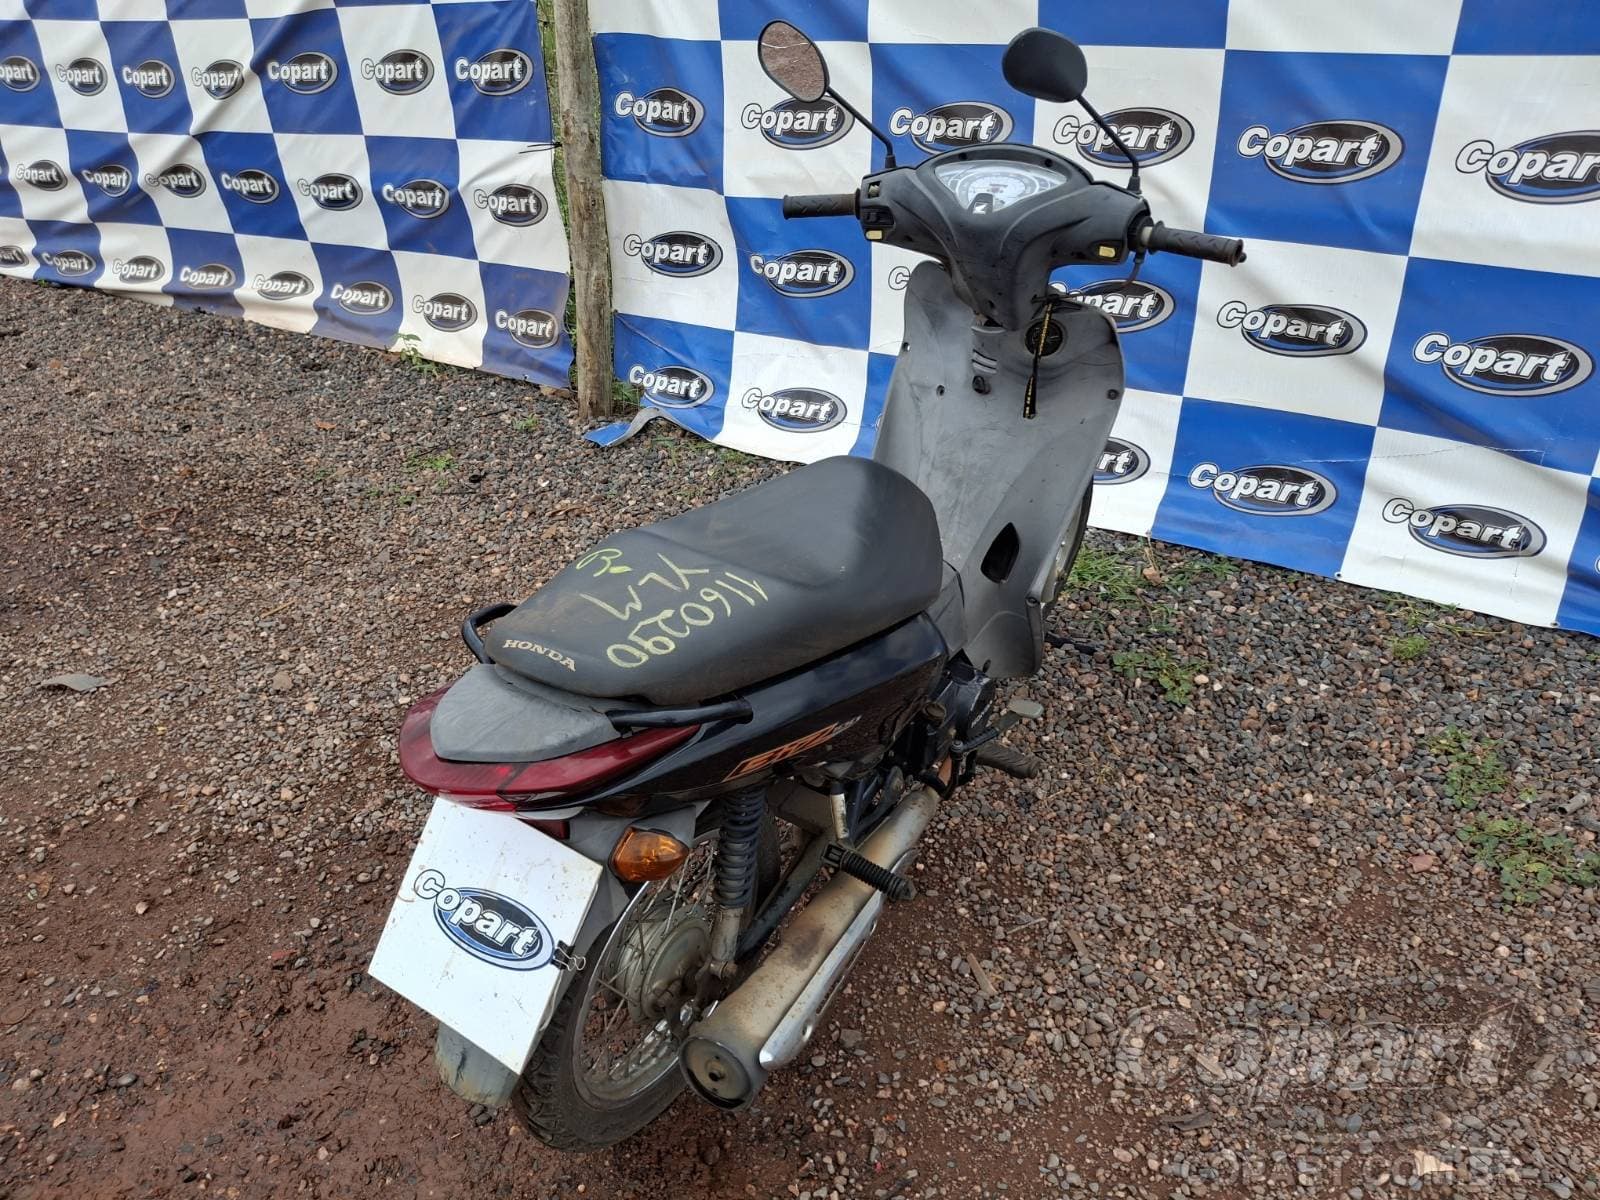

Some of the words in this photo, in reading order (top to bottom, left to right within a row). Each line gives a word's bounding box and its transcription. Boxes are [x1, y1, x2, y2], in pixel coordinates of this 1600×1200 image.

[55, 64, 101, 86] Copart
[122, 65, 168, 88] Copart
[191, 66, 240, 90] Copart
[267, 57, 329, 85] Copart
[361, 56, 424, 84] Copart
[455, 55, 523, 86] Copart
[615, 91, 691, 124] Copart
[741, 103, 840, 136] Copart
[889, 106, 997, 140] Copart
[1053, 114, 1175, 150] Copart
[1238, 125, 1382, 168] Copart
[16, 163, 59, 183] Copart
[1455, 139, 1600, 186] Copar
[81, 169, 128, 187] Copart
[144, 167, 199, 188] Copart
[221, 173, 273, 194] Copart
[297, 178, 354, 202] Copart
[382, 182, 444, 208] Copart
[474, 188, 538, 216] Copart
[42, 252, 90, 271] Copart
[623, 233, 709, 265] Copart
[112, 258, 158, 279] Copart
[179, 266, 230, 287] Copart
[750, 253, 841, 285] Copart
[253, 274, 307, 294] Copart
[330, 283, 385, 307] Copart
[412, 294, 470, 322] Copart
[495, 310, 556, 339] Copart
[1217, 300, 1349, 347] Copart
[1414, 332, 1571, 384] Copart
[629, 364, 701, 399] Copart
[742, 387, 834, 422] Copart
[1188, 460, 1321, 509] Copart
[1382, 496, 1527, 550] Copart
[502, 638, 577, 672] HONDA
[413, 868, 539, 957] Copart
